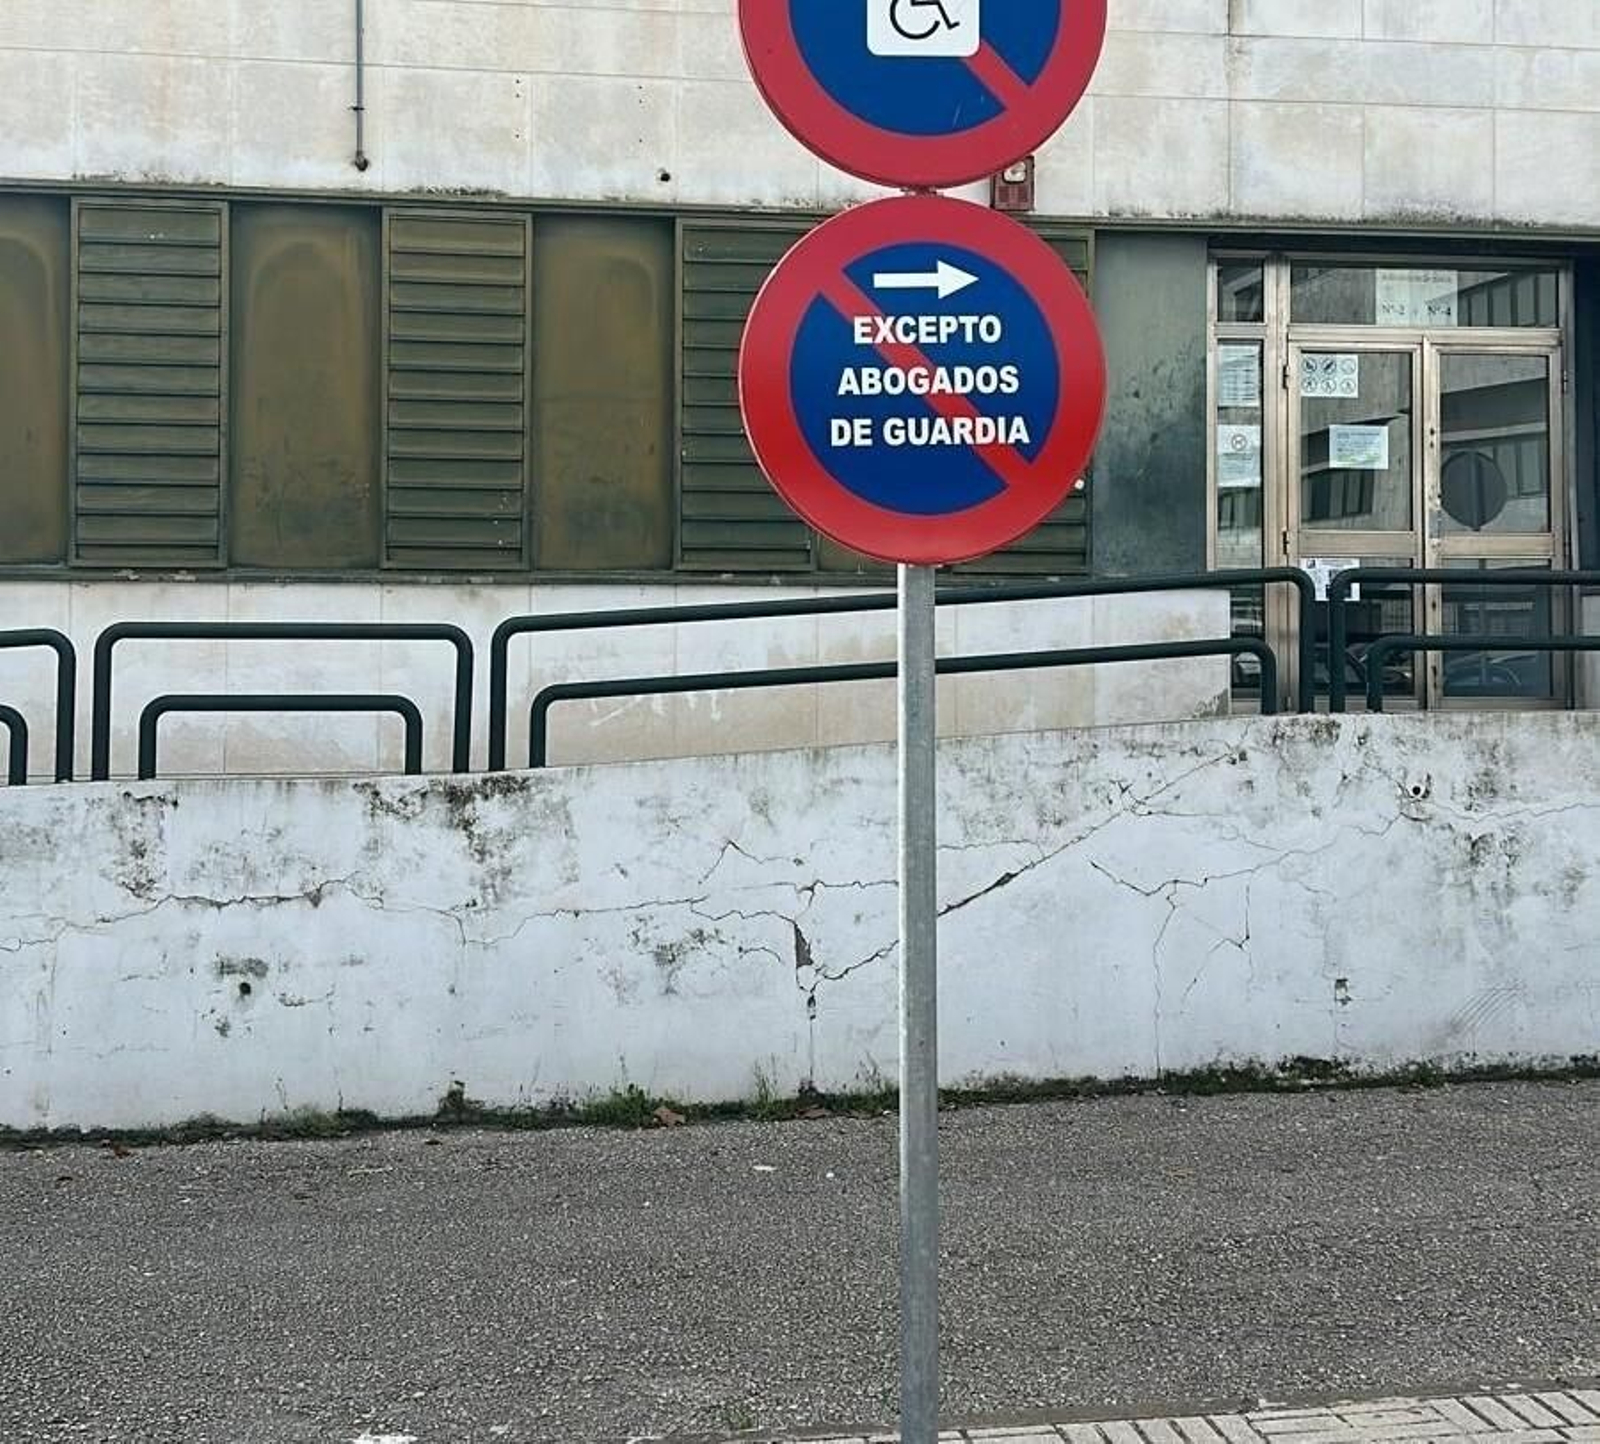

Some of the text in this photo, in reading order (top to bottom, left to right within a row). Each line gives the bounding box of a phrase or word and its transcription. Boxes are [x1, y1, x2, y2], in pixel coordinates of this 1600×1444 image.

[853, 315, 1002, 344] EXCEPTO
[837, 365, 1020, 395] ABOGADOS
[830, 416, 1030, 446] DE GUARDIA
